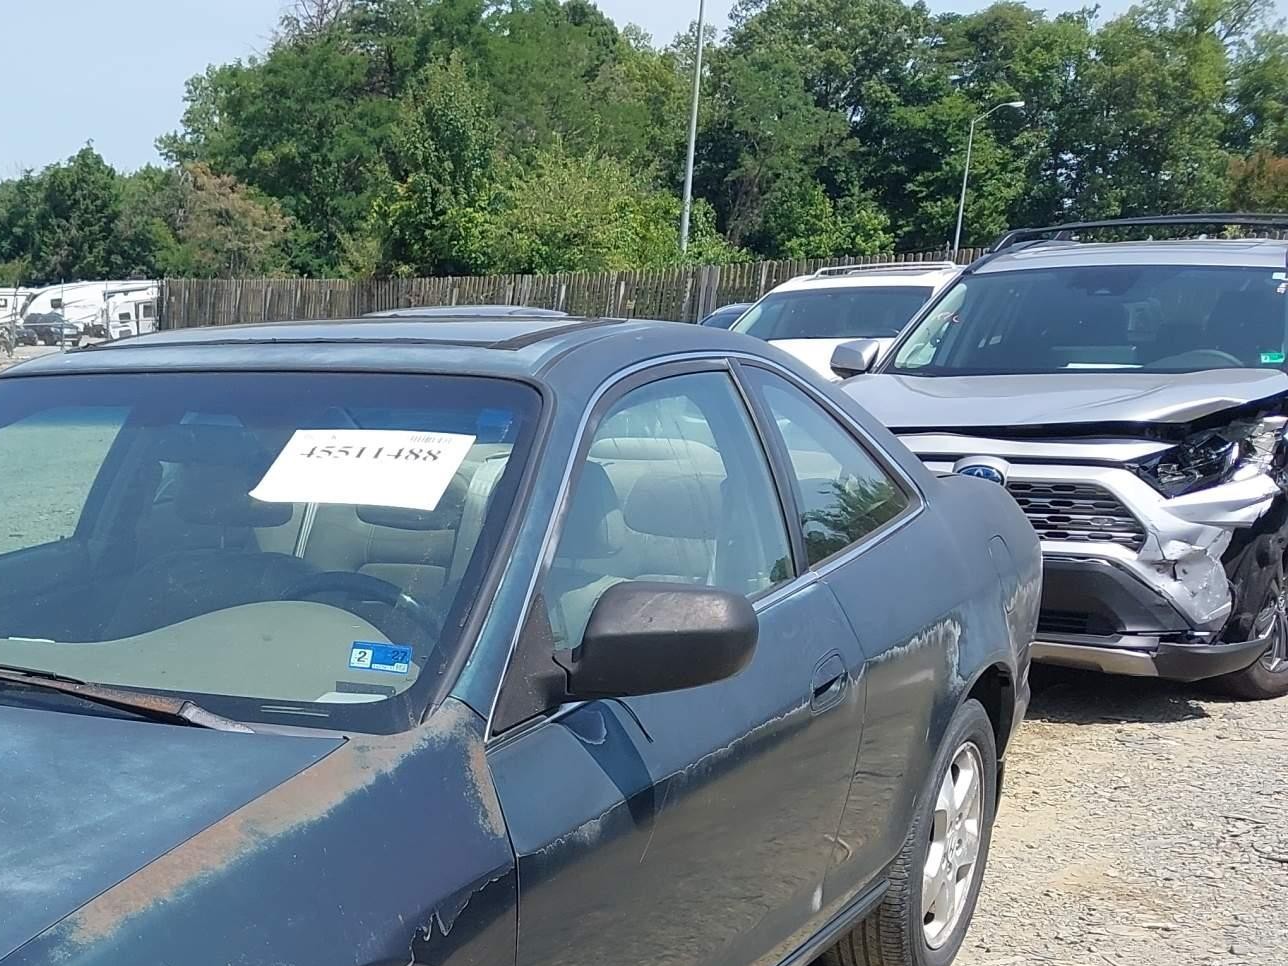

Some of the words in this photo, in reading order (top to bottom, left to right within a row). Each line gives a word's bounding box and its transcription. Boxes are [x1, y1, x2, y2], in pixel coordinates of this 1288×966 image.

[298, 444, 443, 464] 45511488
[356, 649, 368, 663] 2
[390, 649, 408, 663] 27
